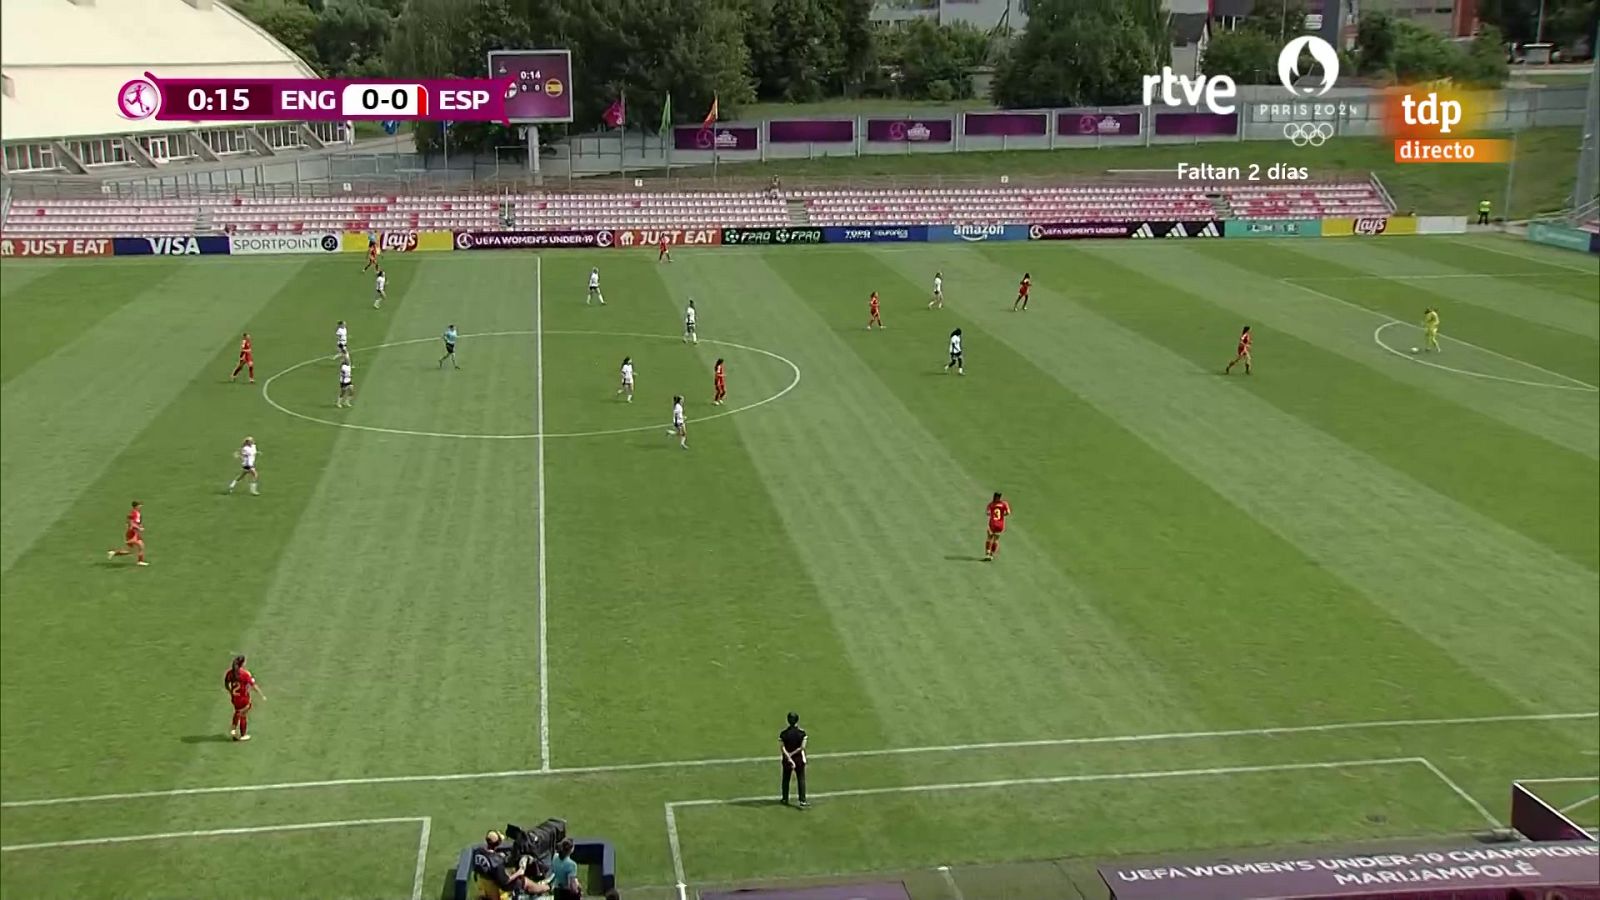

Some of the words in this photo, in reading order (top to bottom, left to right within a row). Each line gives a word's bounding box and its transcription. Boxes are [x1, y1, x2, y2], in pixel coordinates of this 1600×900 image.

[520, 71, 541, 79] 0:14
[953, 224, 1005, 235] amazon
[475, 236, 501, 245] UEFA
[502, 235, 548, 245] WOMEN'S
[549, 235, 594, 244] UNDER-19
[684, 229, 718, 244] EAT
[21, 239, 69, 255] JUST
[72, 239, 109, 254] EAT
[145, 237, 201, 255] VISA
[233, 238, 319, 250] SPORTPOINT
[1117, 866, 1182, 882] UEFA
[1184, 860, 1312, 877] WOMEN'S
[1317, 852, 1444, 869] UNDER-19
